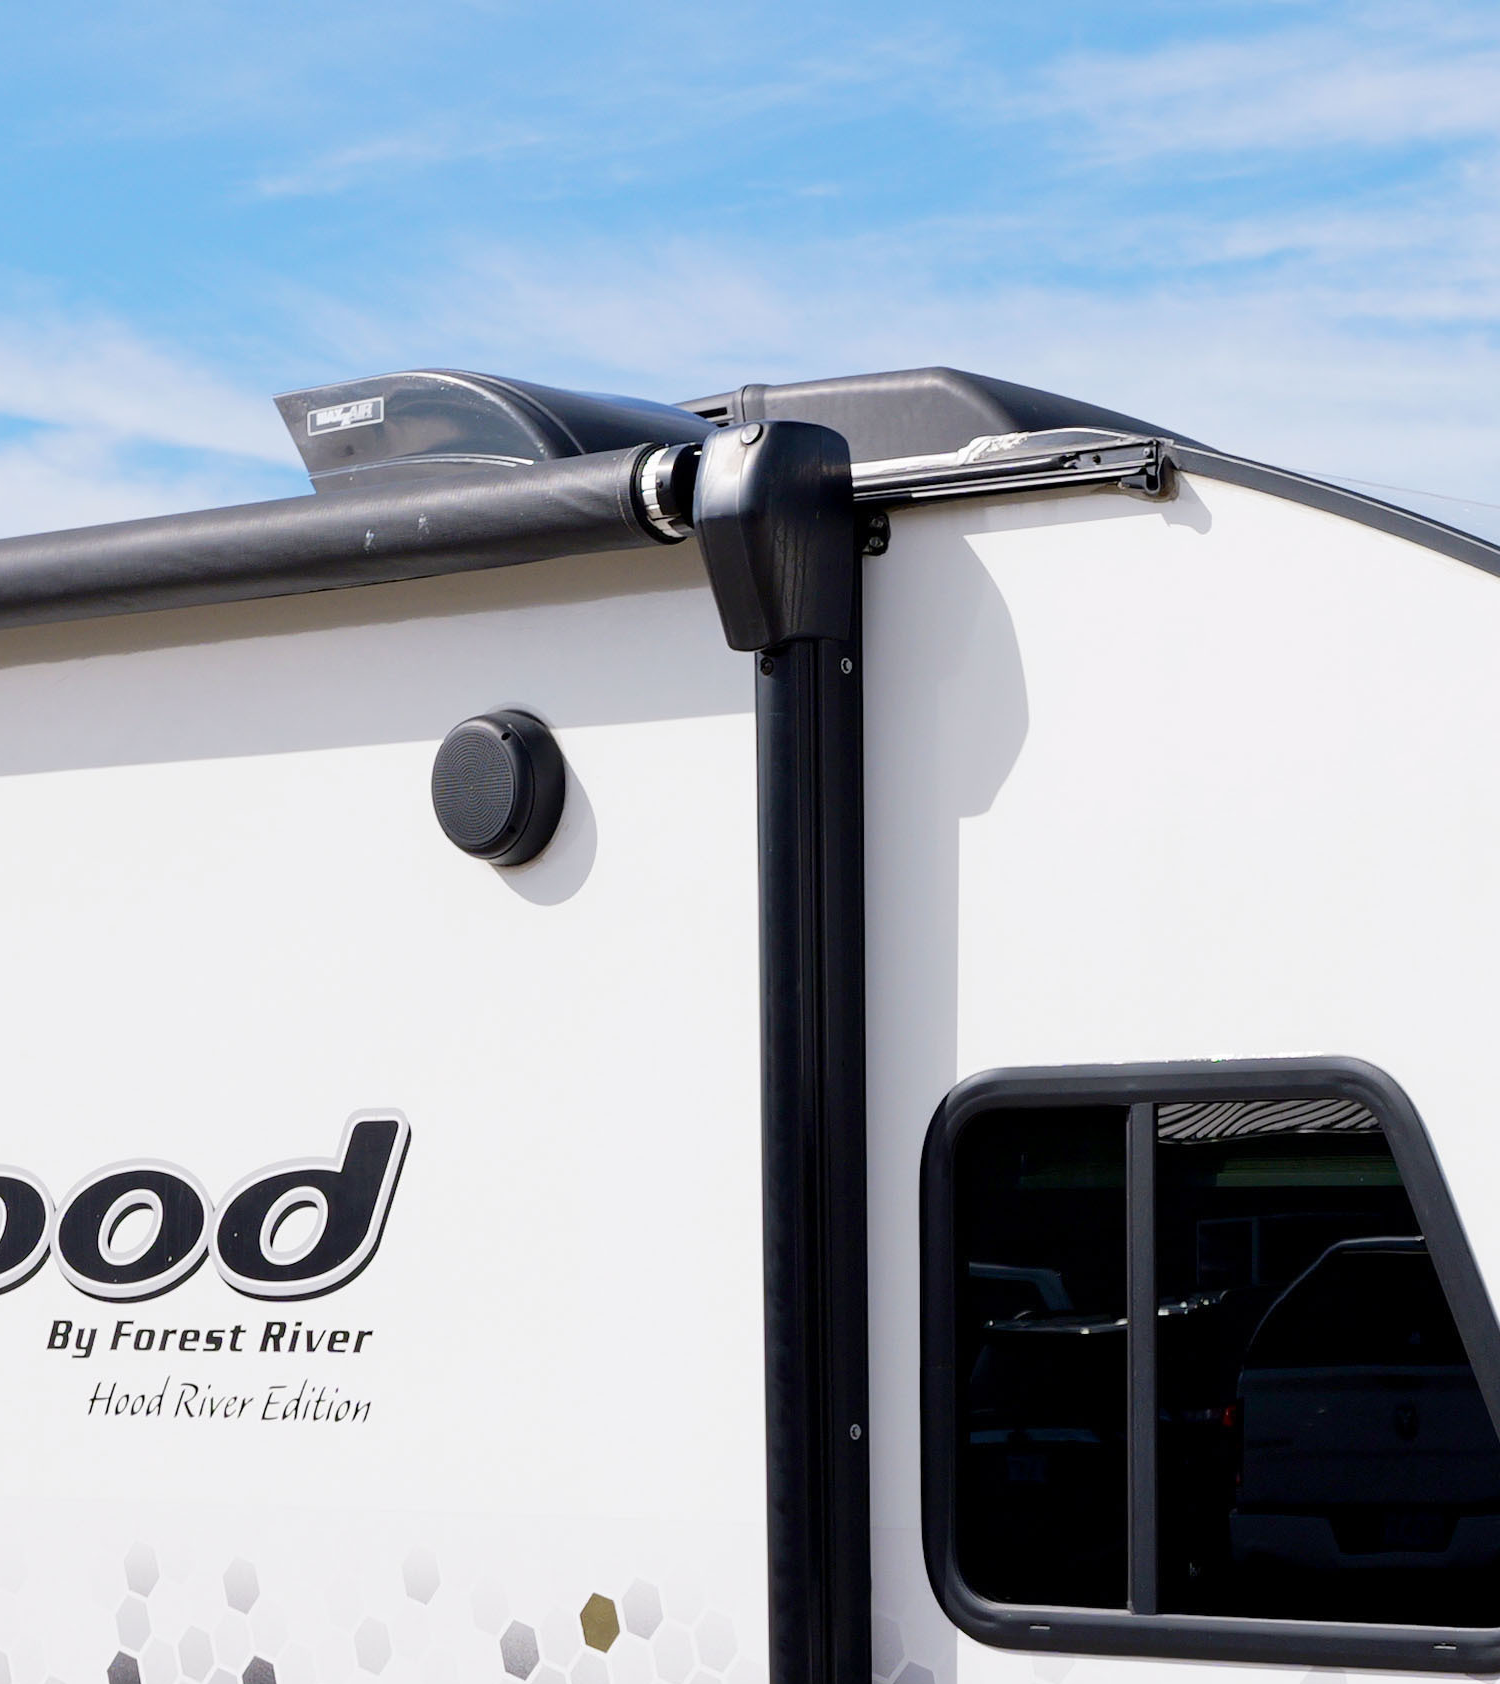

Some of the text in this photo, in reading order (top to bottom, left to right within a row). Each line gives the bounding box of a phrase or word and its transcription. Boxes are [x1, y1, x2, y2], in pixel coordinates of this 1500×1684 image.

[47, 1321, 373, 1358] By Forest River
[89, 1377, 371, 1424] Hood River Edition
